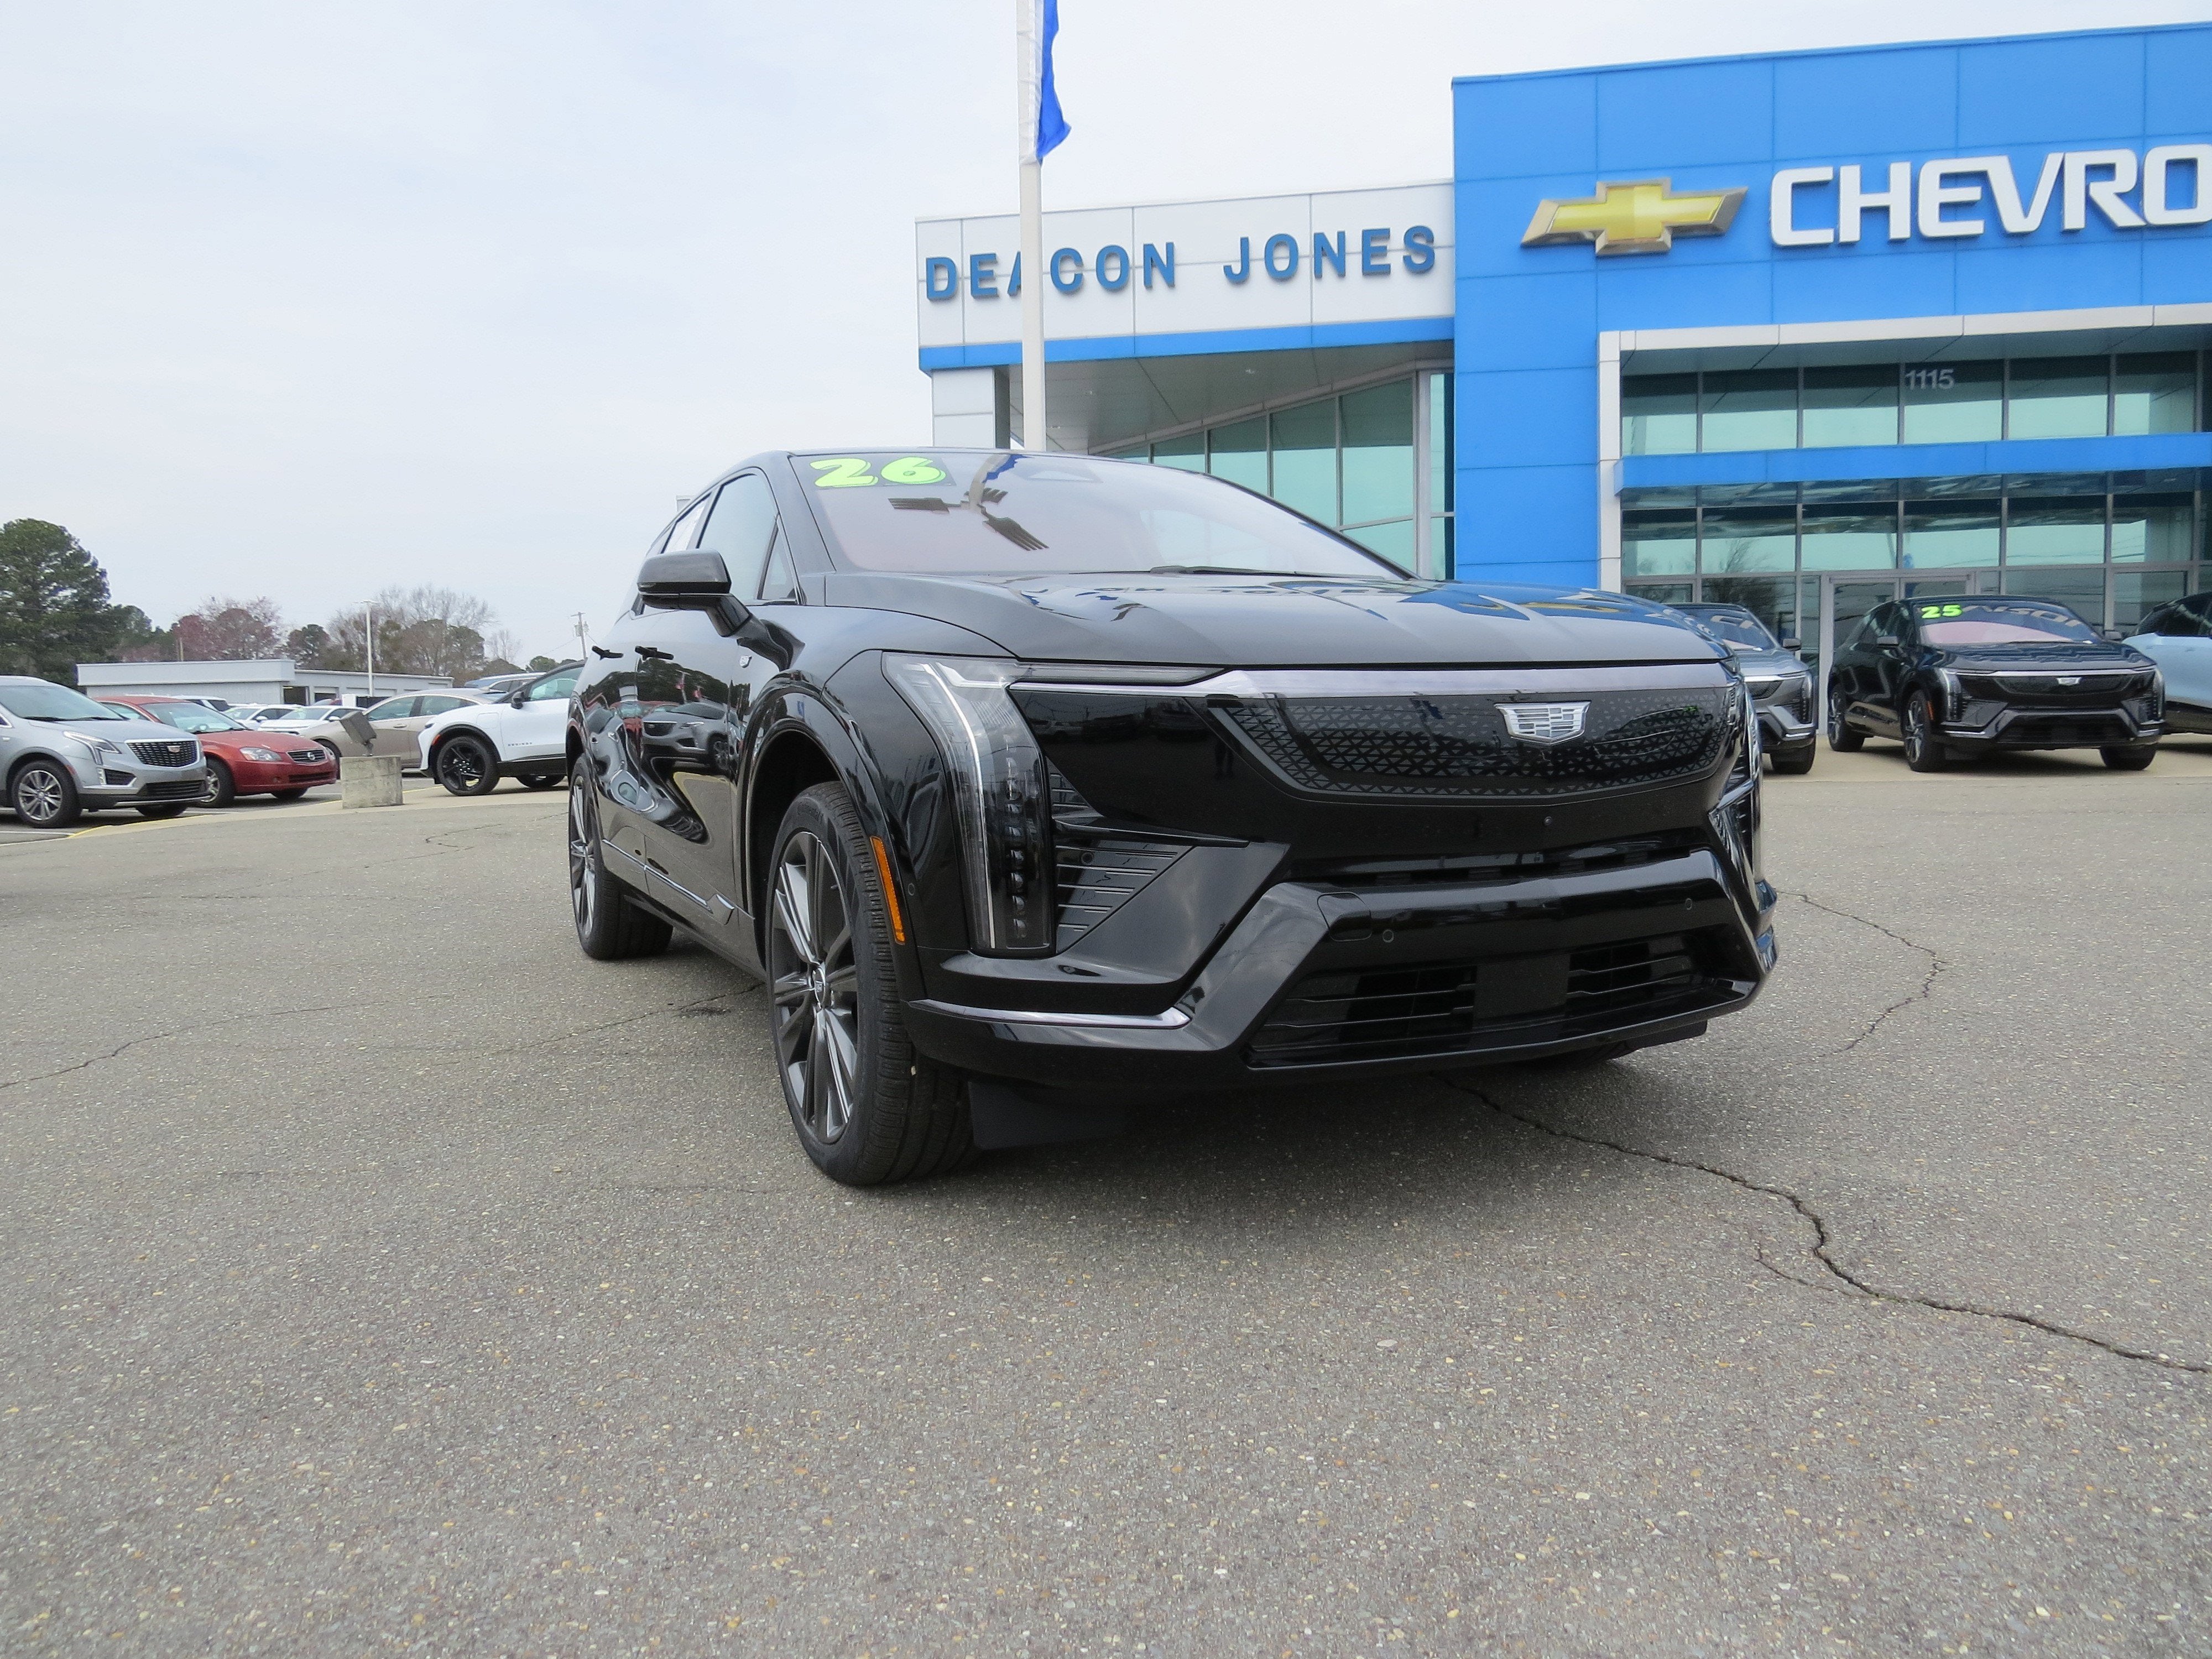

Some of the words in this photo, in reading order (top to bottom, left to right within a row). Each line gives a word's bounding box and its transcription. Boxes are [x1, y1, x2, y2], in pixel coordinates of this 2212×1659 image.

[1770, 143, 2212, 247] CHEVRO
[1223, 225, 1436, 284] JONES
[1905, 368, 1954, 390] 1115
[810, 456, 946, 487] 26
[1921, 604, 1962, 619] 25
